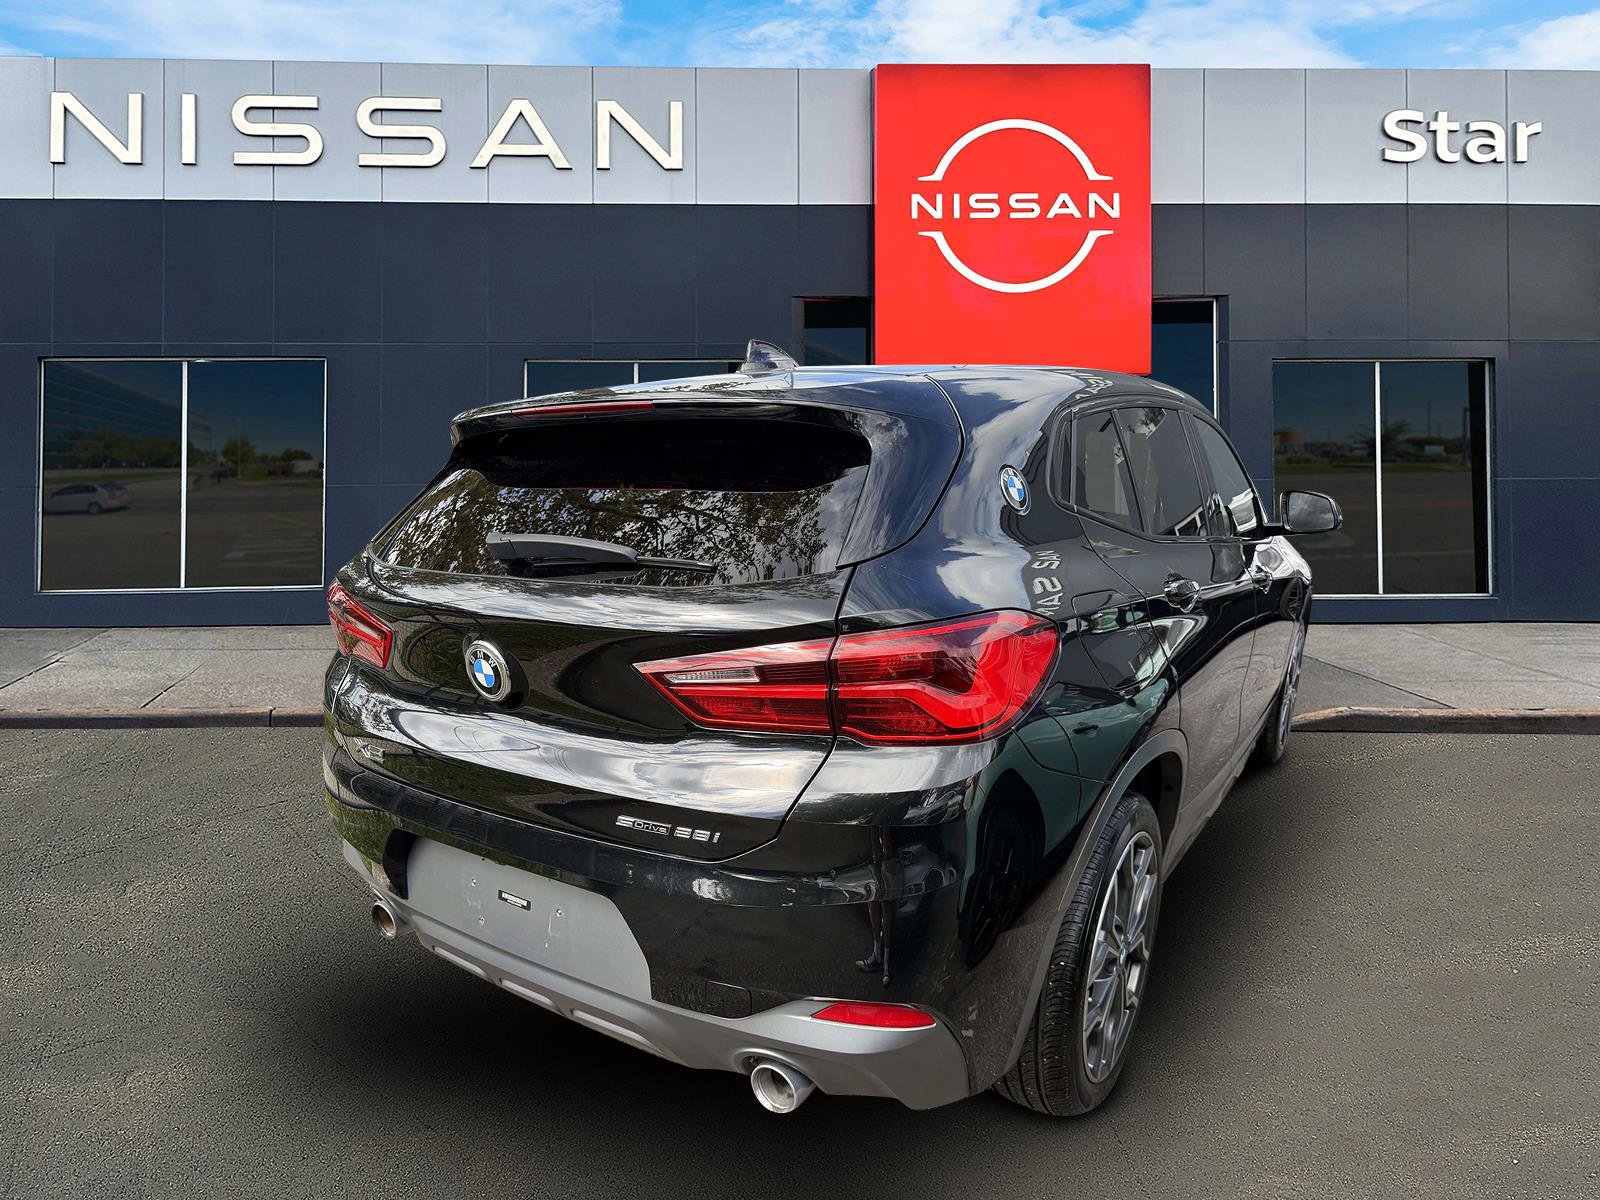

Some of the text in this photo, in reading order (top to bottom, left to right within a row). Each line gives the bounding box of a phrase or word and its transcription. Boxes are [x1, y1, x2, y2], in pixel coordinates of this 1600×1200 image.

[49, 91, 684, 170] NISSAN
[1381, 108, 1543, 164] Star
[910, 191, 1121, 221] NISSAN
[673, 826, 721, 844] 28i
